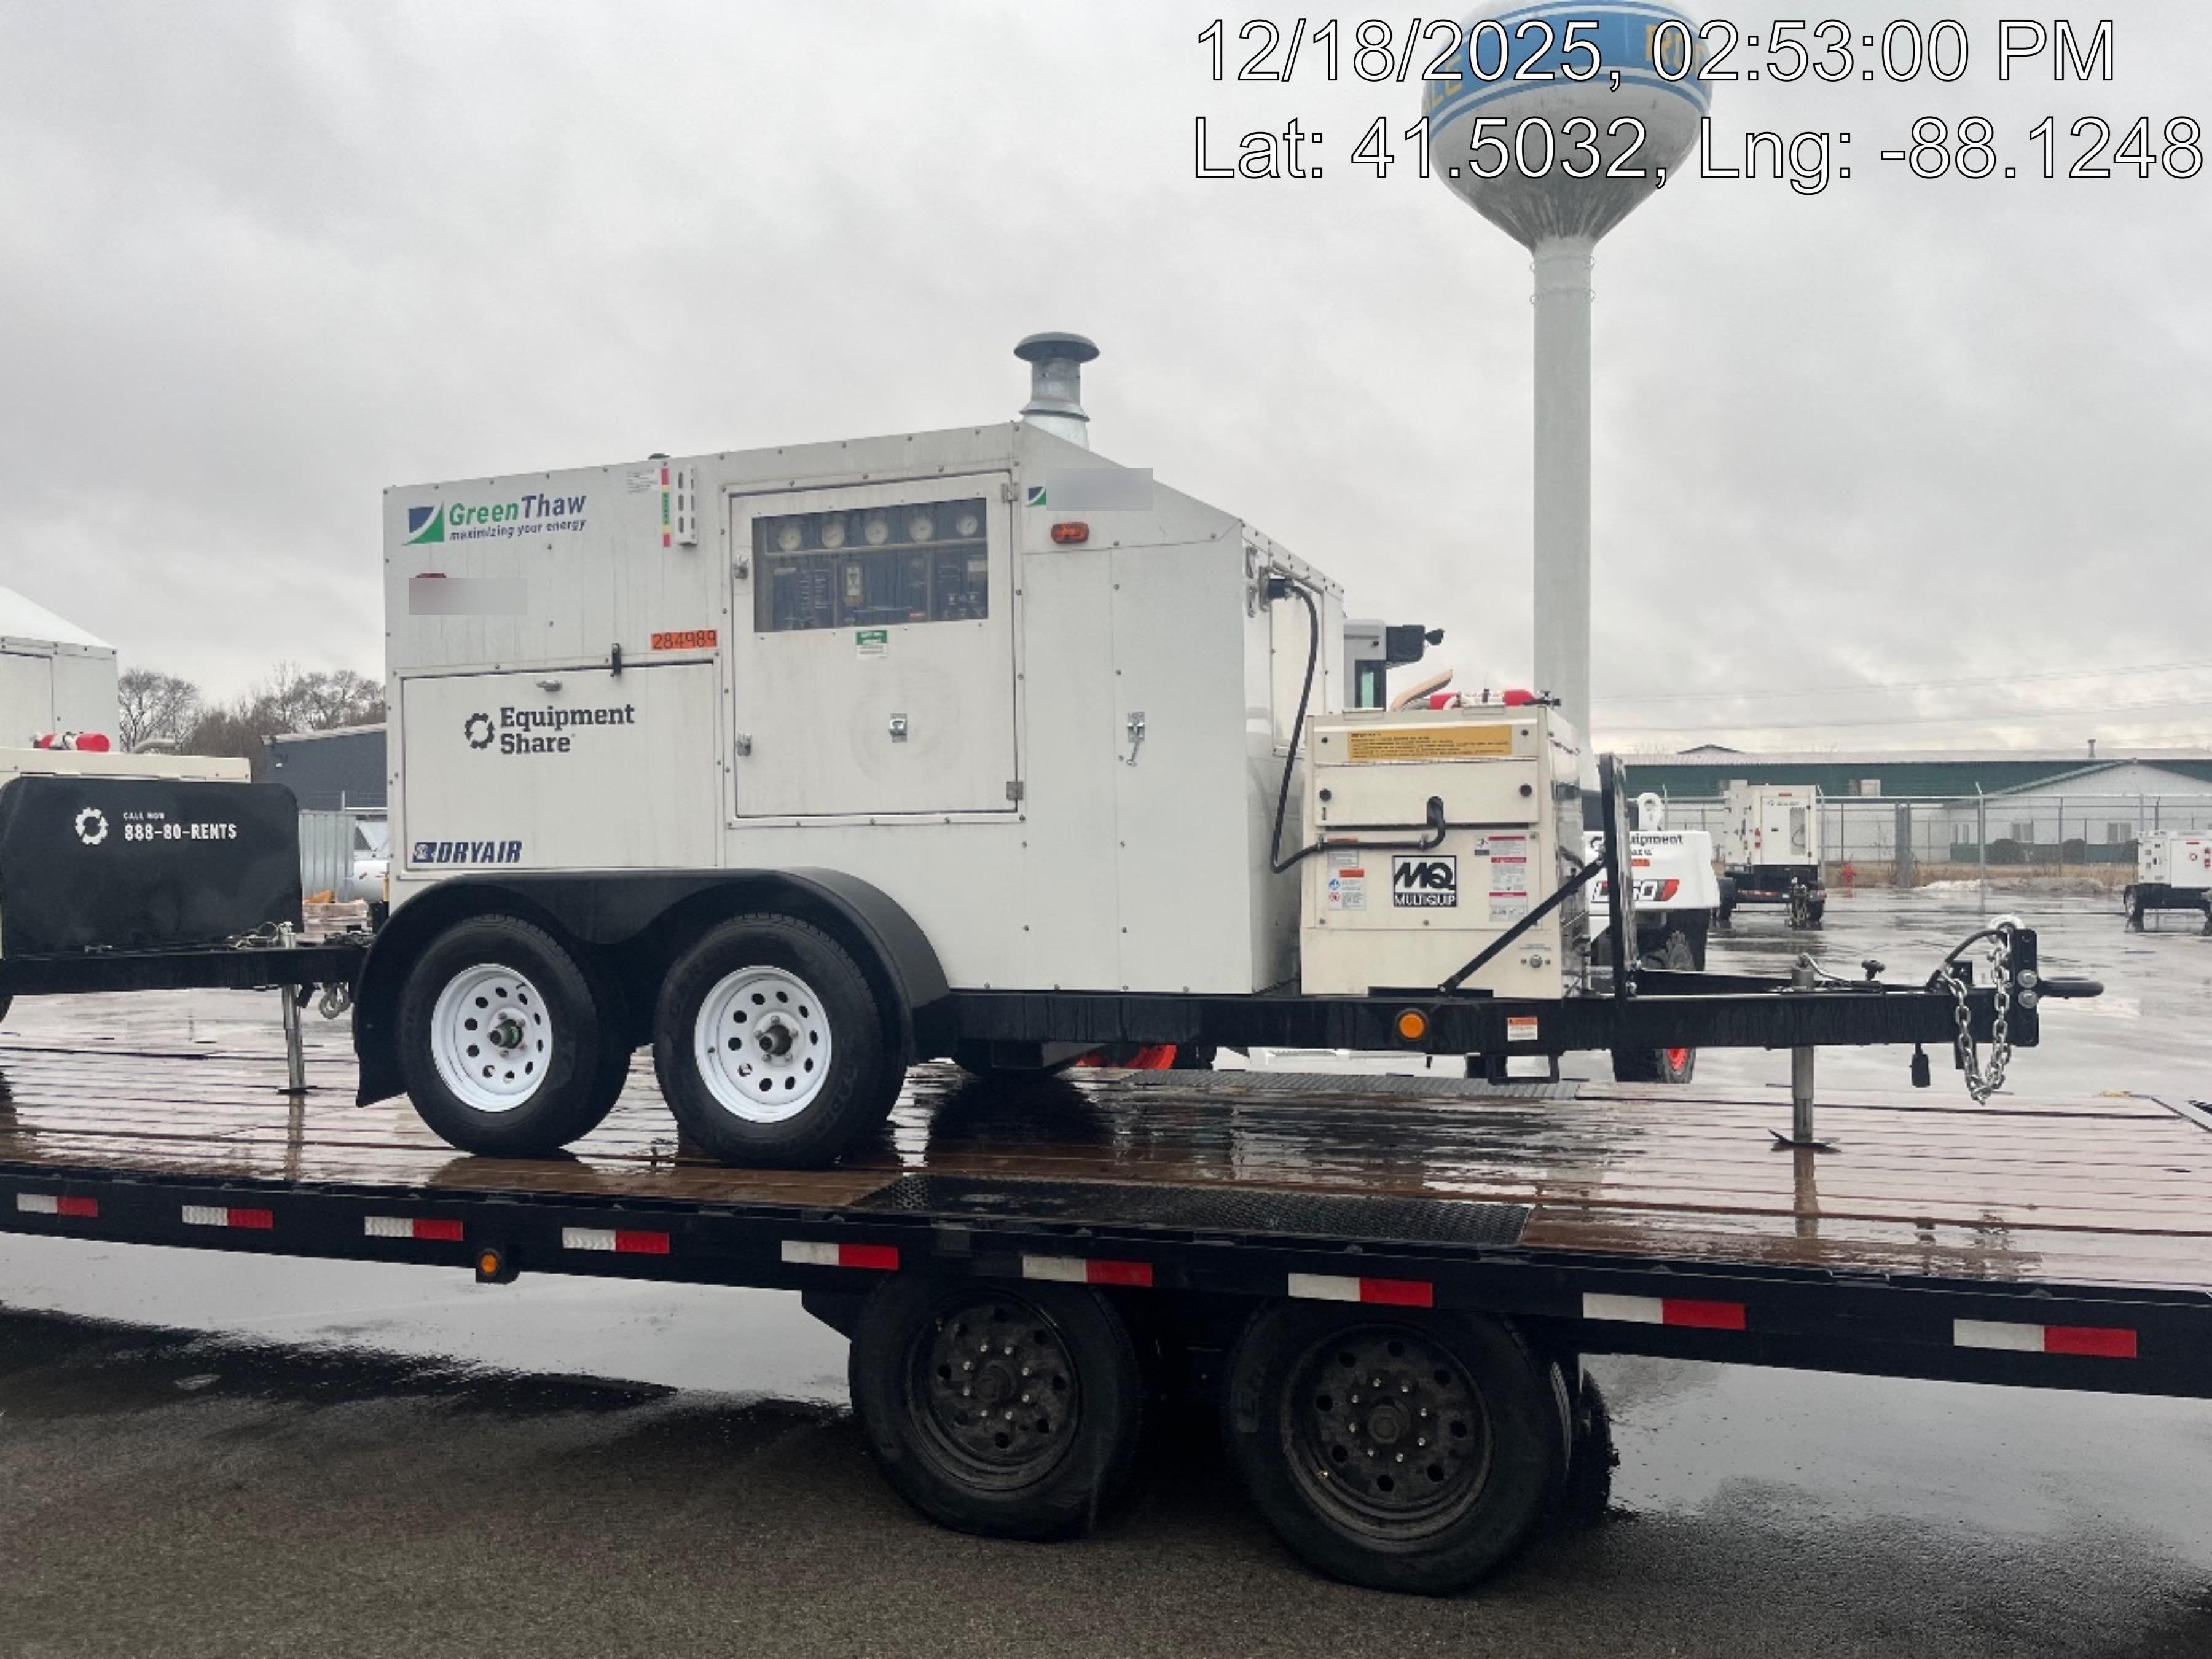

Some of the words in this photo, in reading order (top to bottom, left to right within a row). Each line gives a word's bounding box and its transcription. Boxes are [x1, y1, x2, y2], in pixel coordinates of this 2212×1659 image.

[449, 524, 515, 541] maximizing
[517, 523, 543, 536] your
[546, 519, 587, 532] energy
[652, 630, 716, 649] 284989
[500, 704, 635, 732] Equipment
[500, 733, 570, 754] Share
[147, 812, 165, 820] NOW
[124, 823, 237, 841] 888-80-RENTS
[436, 840, 522, 863] DRYAIR
[1393, 862, 1456, 890] MQ
[1395, 893, 1456, 906] MULTIQUIP
